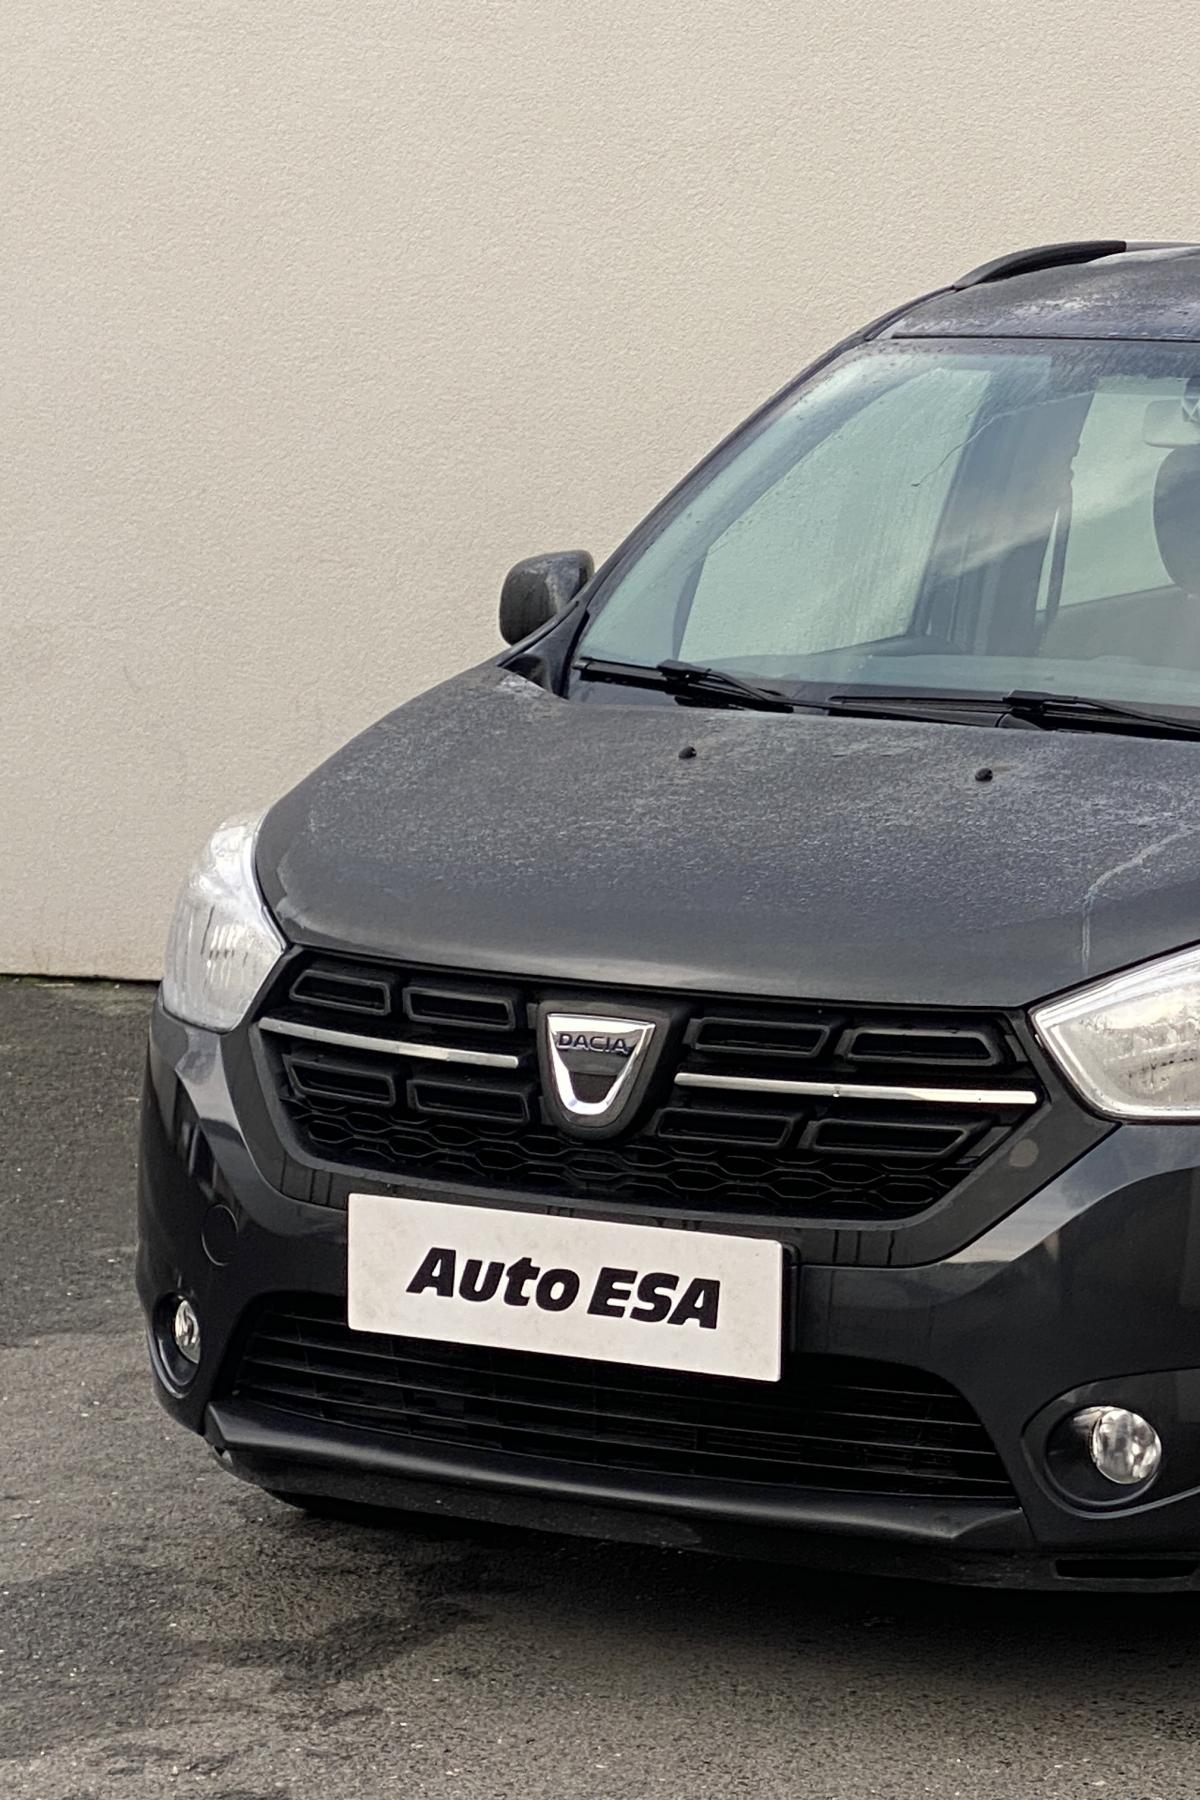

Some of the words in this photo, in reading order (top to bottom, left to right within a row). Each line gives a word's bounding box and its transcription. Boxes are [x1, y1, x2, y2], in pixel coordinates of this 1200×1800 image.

[558, 1033, 629, 1054] DACIA
[405, 1247, 581, 1312] Auto
[586, 1266, 720, 1330] ESA
